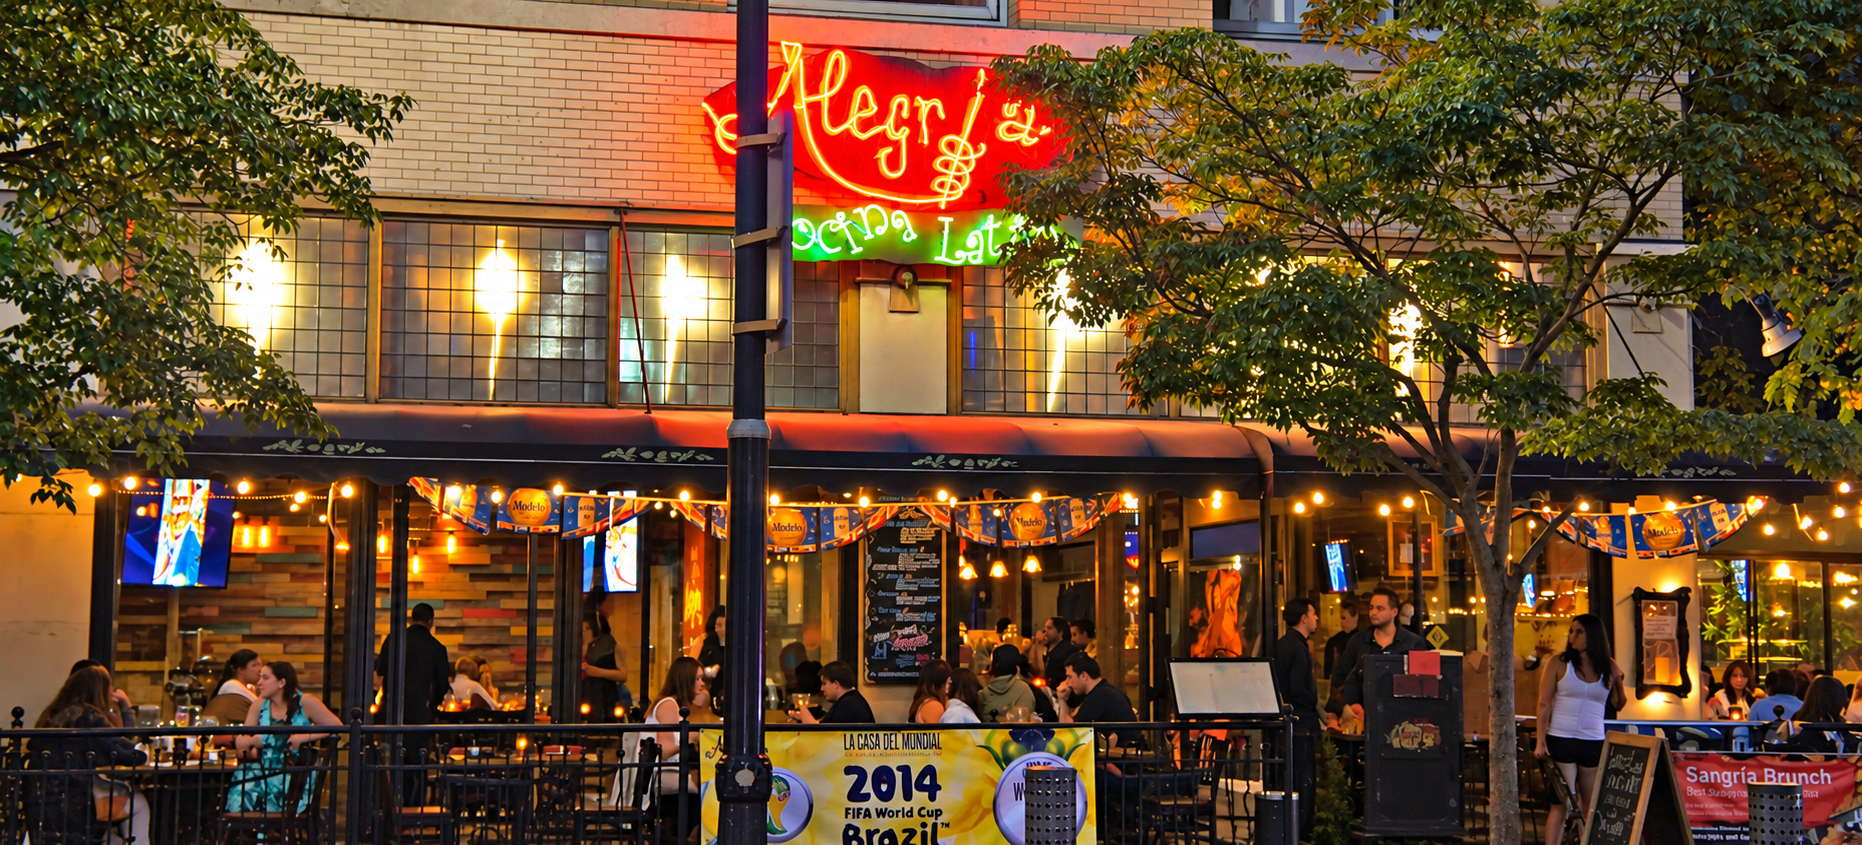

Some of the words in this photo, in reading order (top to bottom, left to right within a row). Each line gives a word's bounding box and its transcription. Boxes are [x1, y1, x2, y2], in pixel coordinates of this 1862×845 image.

[512, 500, 546, 512] Modelo
[772, 522, 803, 532] Modelo
[843, 733, 855, 750] LA
[857, 733, 880, 750] CASA
[883, 733, 899, 750] DEL
[902, 732, 942, 750] MUNDIAL
[843, 764, 942, 803] 2014
[1686, 766, 1757, 788] Sangría
[1763, 768, 1832, 784] Brunch
[844, 807, 872, 819] FIFA
[875, 806, 914, 819] World
[917, 806, 943, 820] Cup
